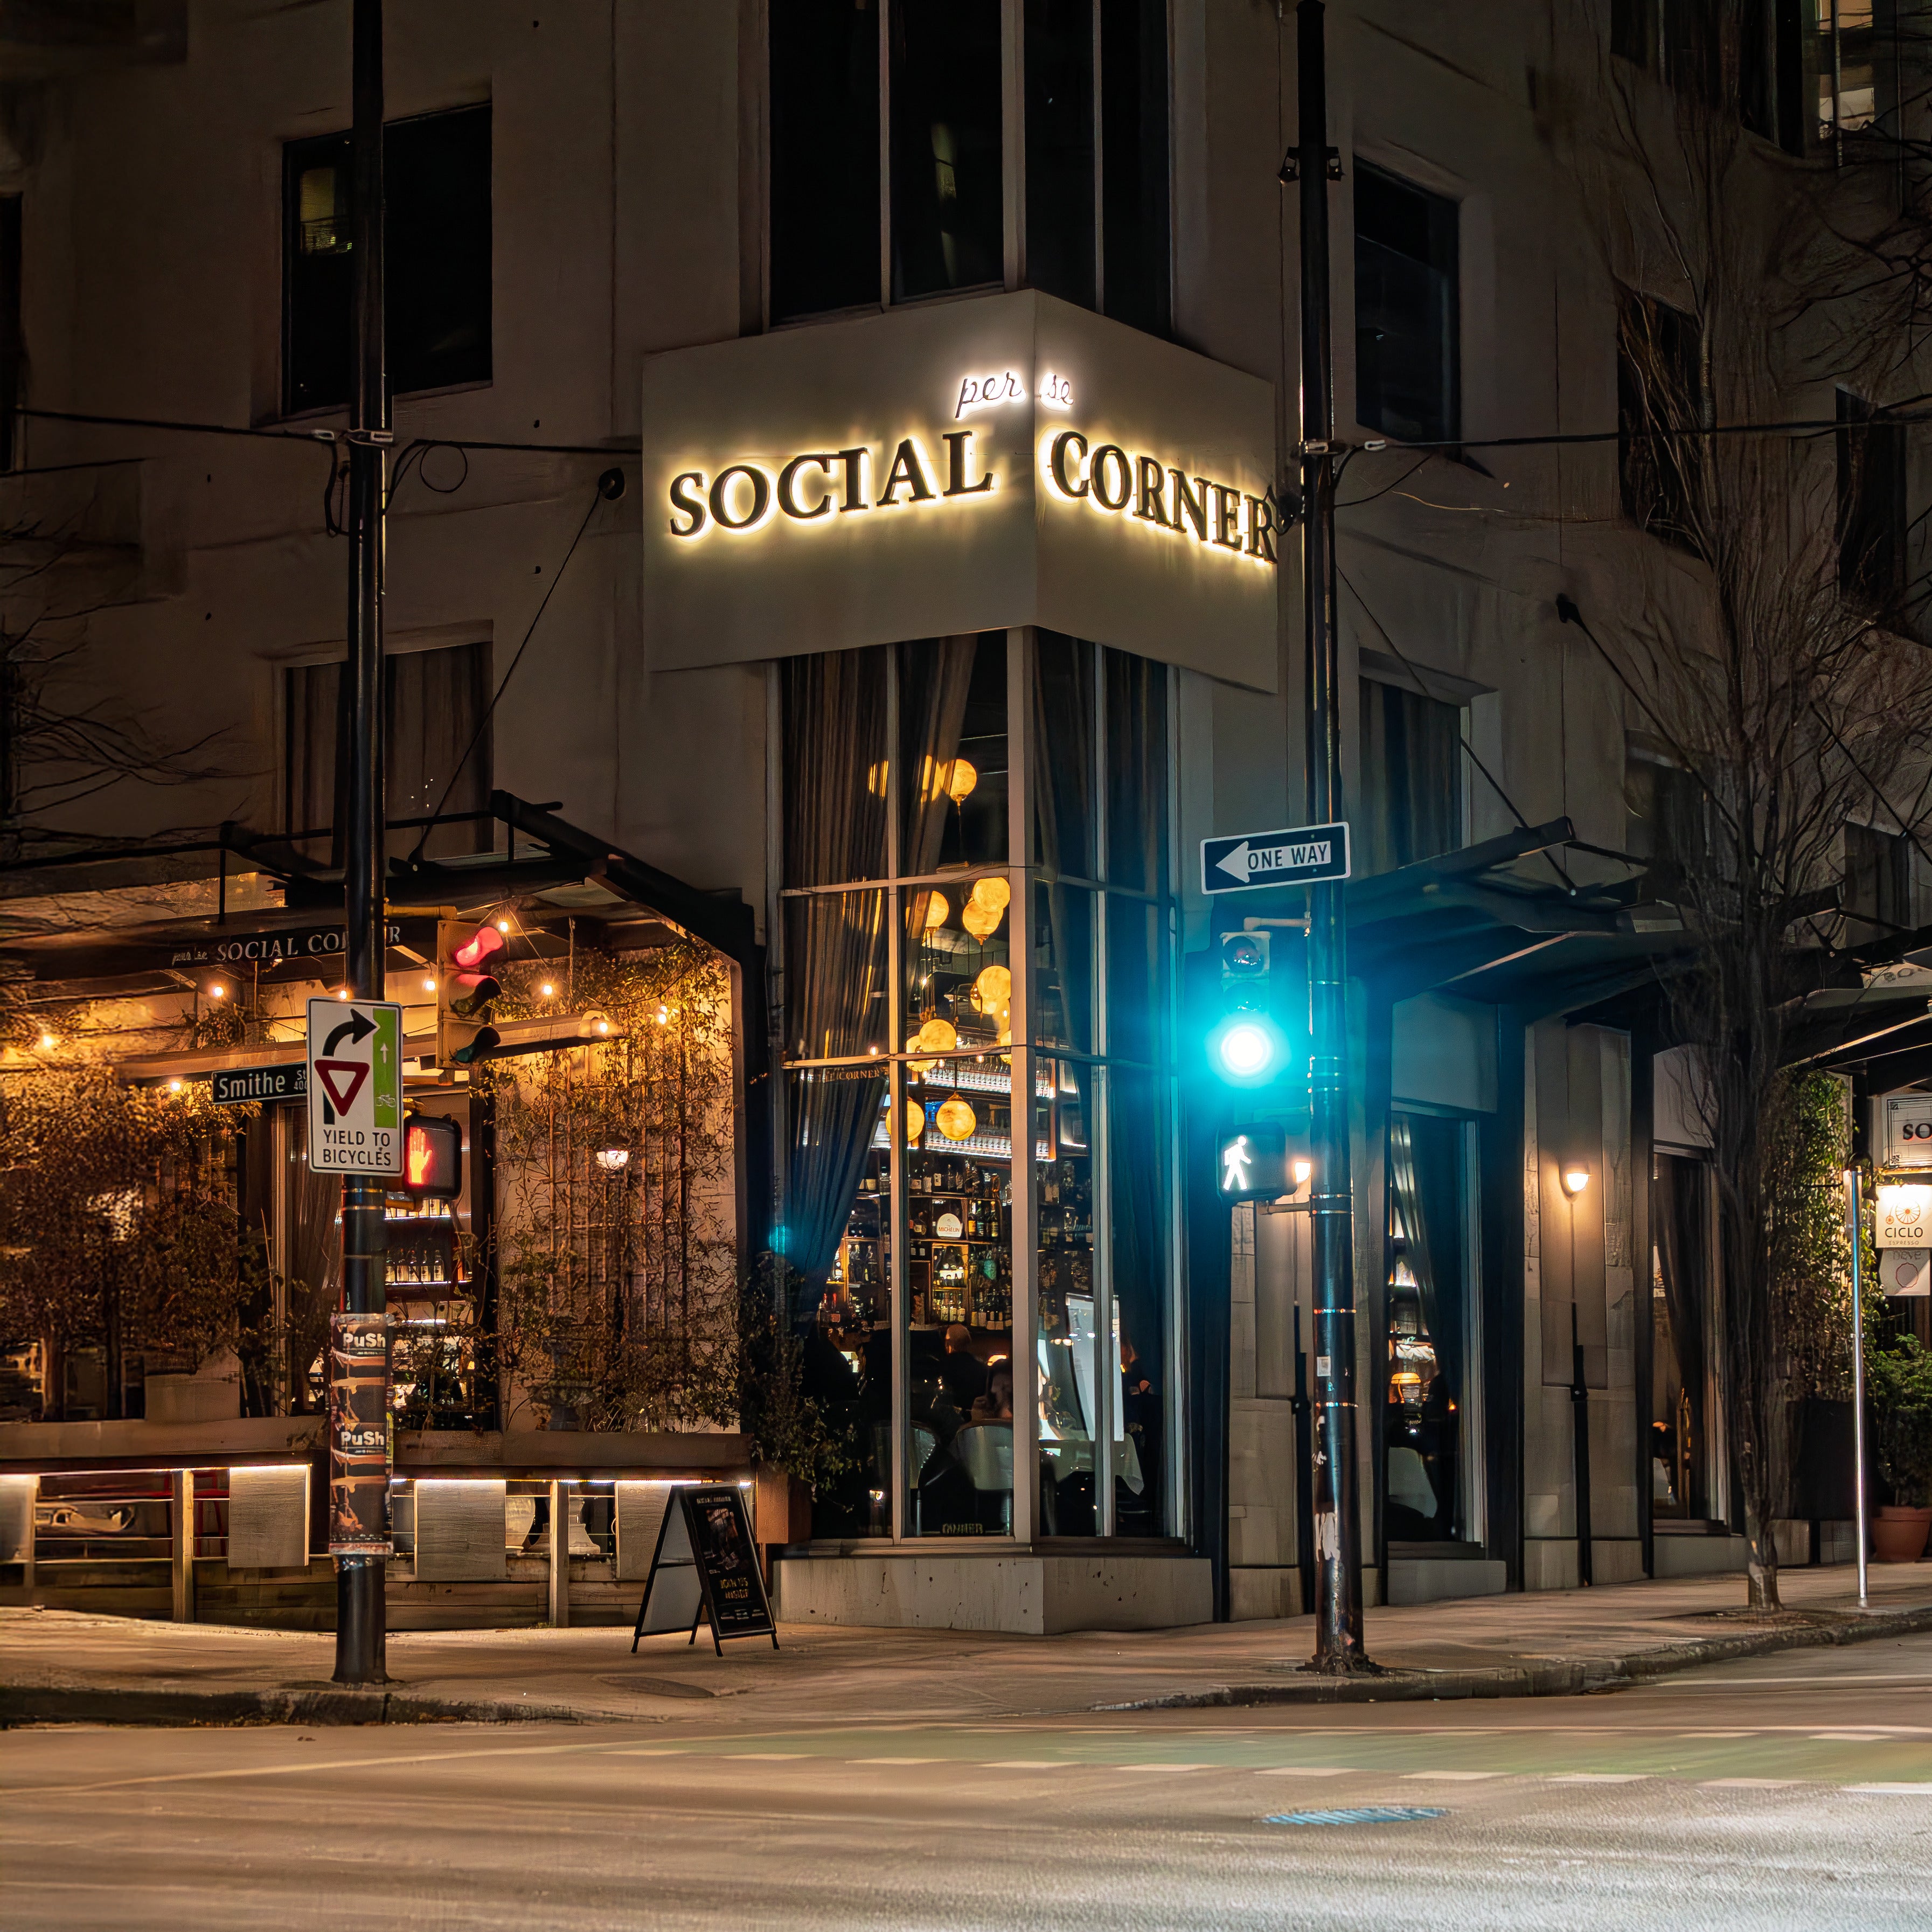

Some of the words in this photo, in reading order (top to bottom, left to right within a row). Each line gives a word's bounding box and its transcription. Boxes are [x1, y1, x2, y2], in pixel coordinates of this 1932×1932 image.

[955, 372, 1021, 419] per
[1047, 374, 1074, 405] se
[670, 430, 992, 537] SOCIAL
[1051, 430, 1277, 564] CORNER
[1248, 850, 1283, 870] ONE
[1291, 844, 1328, 865] WAY
[217, 938, 298, 961] SOCIAL
[219, 1072, 286, 1098] Smithe
[323, 1129, 365, 1145] YIELD
[372, 1132, 390, 1147] TO
[323, 1149, 391, 1166] BICYCLES
[1885, 1227, 1923, 1238] CICLO
[343, 1333, 386, 1347] PuSh
[341, 1431, 384, 1445] PuSh
